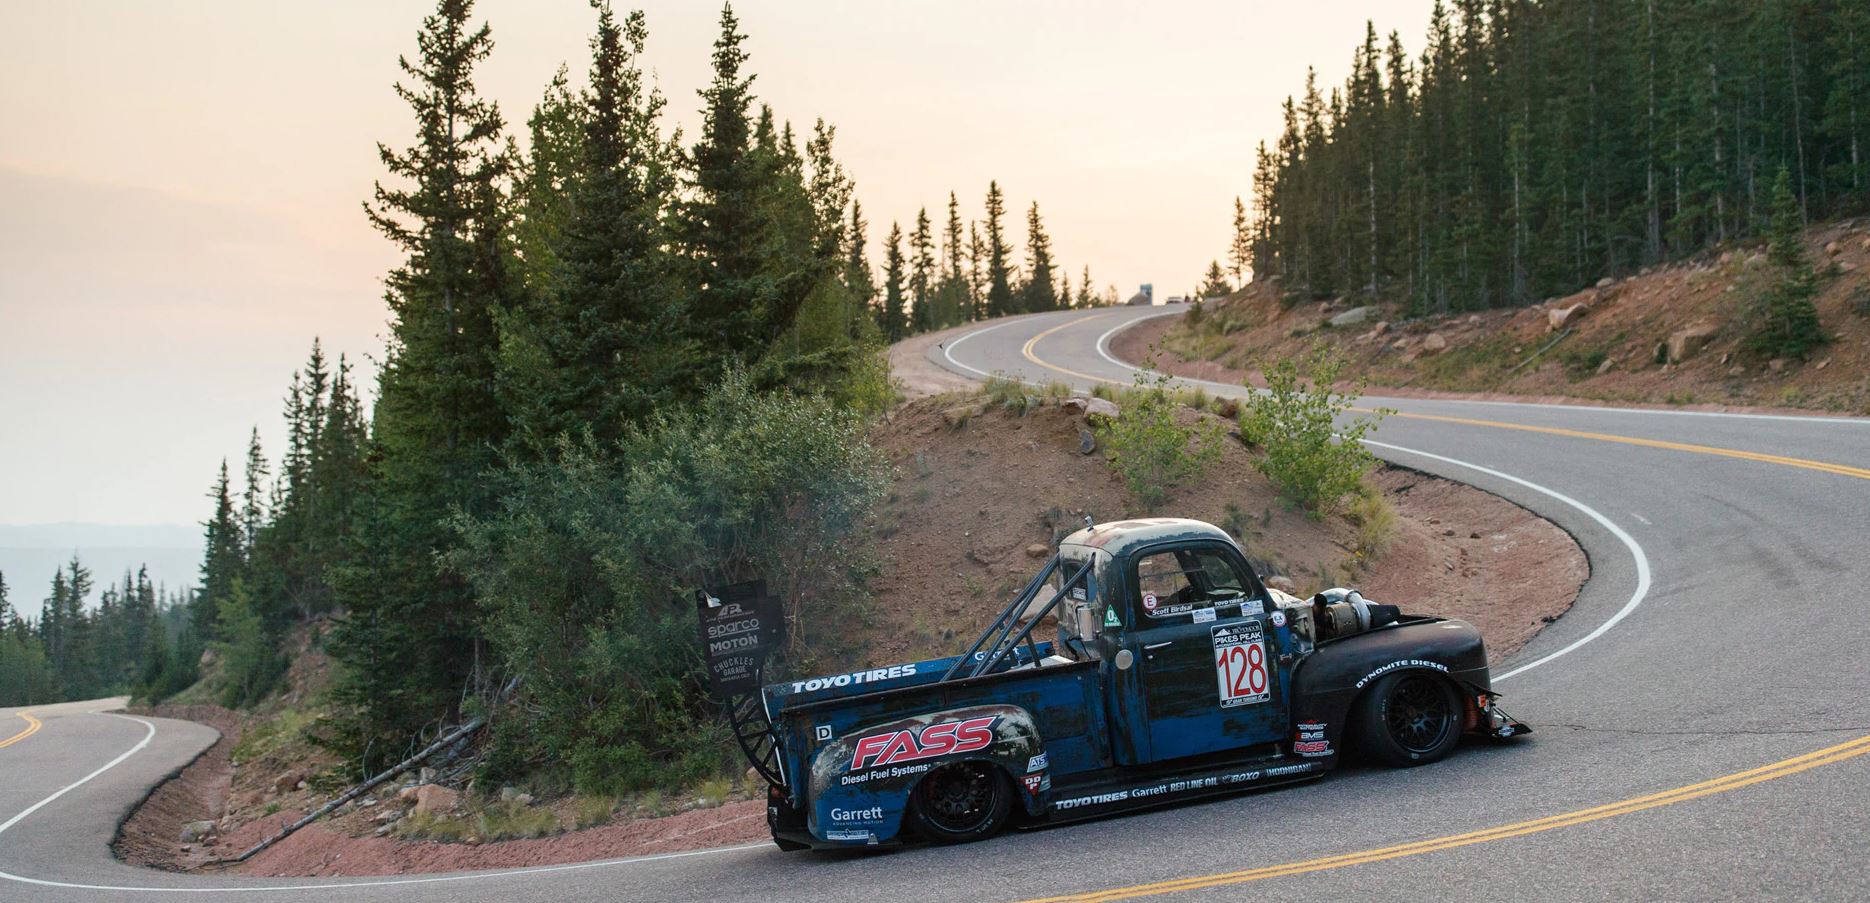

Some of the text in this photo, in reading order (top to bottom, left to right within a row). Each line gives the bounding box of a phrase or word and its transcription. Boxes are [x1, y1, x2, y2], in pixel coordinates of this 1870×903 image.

[1152, 607, 1169, 616] Scott
[707, 618, 759, 638] sparco
[709, 635, 758, 653] MOTON
[1215, 635, 1238, 644] PIKES
[1239, 632, 1261, 641] PEAK
[723, 665, 747, 677] GARAGE
[1218, 643, 1267, 698] 128
[1355, 659, 1449, 689] DYNOMITE DIESEL
[819, 727, 830, 739] D
[851, 716, 996, 770] FASS
[841, 772, 869, 786] Diesel
[870, 769, 890, 780] Fuel
[1132, 785, 1167, 797] Garrett
[1170, 781, 1185, 792] RED
[1187, 779, 1203, 790] LINE
[1205, 777, 1218, 787] OIL
[1231, 771, 1260, 783] BOXO
[830, 806, 883, 821] Garrett
